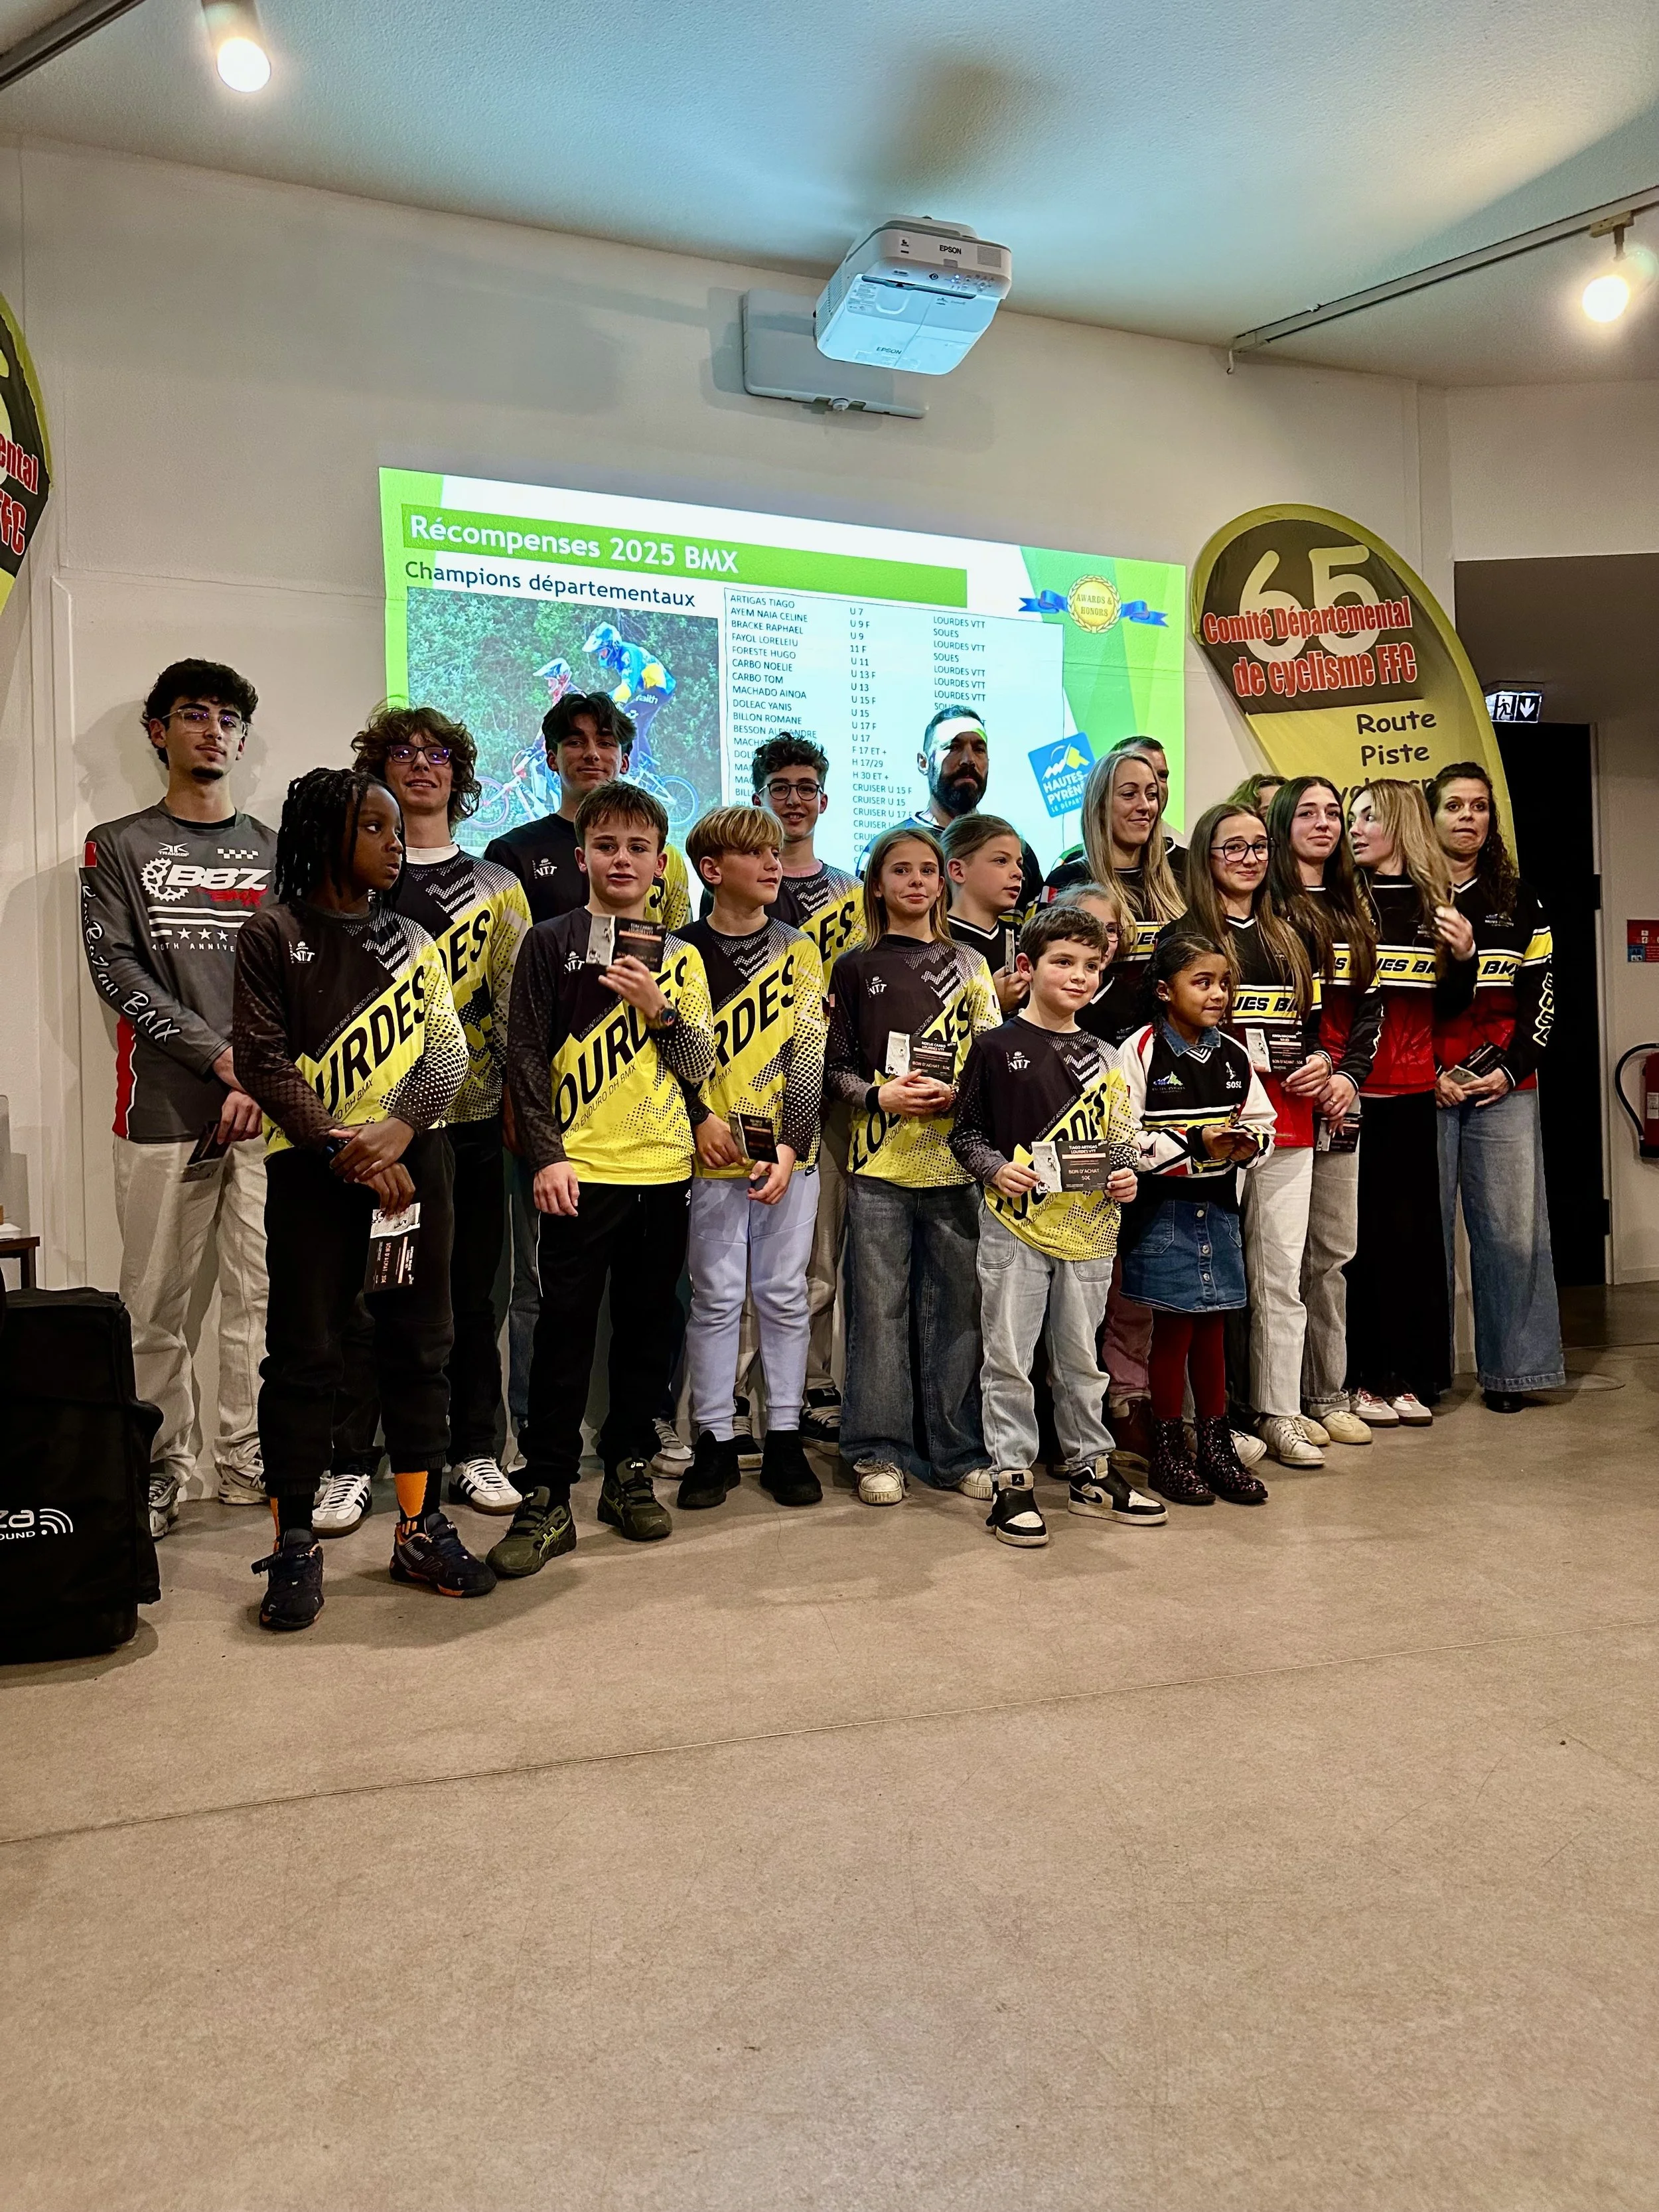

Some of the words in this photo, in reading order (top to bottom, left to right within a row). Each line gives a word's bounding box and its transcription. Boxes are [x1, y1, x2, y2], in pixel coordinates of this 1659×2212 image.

[939, 245, 962, 255] EPSON
[876, 346, 902, 355] EPSON
[409, 514, 601, 559] Récompenses
[610, 536, 676, 566] 2025
[685, 546, 739, 574] BMX
[405, 560, 521, 589] Champions
[529, 573, 696, 607] départementaux
[730, 595, 766, 605] ARTIGAS
[769, 599, 795, 609] TIAGO
[1076, 593, 1106, 604] AWARDS
[1239, 544, 1380, 664] 65
[731, 607, 755, 617] AYEM
[757, 610, 778, 619] NAIA
[780, 612, 808, 623] CELINE
[1080, 606, 1108, 617] HONORS
[933, 616, 969, 627] LOURDES
[971, 621, 985, 629] VTT
[1203, 609, 1273, 644] Comité
[1273, 595, 1413, 640] Départemental
[731, 620, 764, 630] BRACKE
[766, 623, 804, 634] RAPHAEL
[933, 628, 960, 638] SOUES
[732, 632, 757, 643] FAYOL
[850, 644, 859, 653] 11
[933, 640, 970, 651] LOURDES
[732, 646, 768, 656] FORESTE
[770, 650, 796, 659] HUGO
[933, 652, 960, 662] SOUES
[732, 658, 761, 669] CARBO
[764, 662, 793, 672] NOELIE
[1232, 656, 1266, 698] de
[1267, 650, 1376, 698] cyclisme
[1376, 642, 1417, 685] FFC
[851, 669, 857, 678] U
[859, 670, 869, 679] 13
[934, 665, 970, 676] LOURDES
[971, 669, 985, 678] VTT
[732, 672, 761, 682] CARBO
[764, 674, 784, 684] TOM
[934, 677, 970, 688] LOURDES
[971, 680, 985, 690] VTT
[732, 685, 778, 697] MACHADO
[779, 689, 807, 699] AINOA
[851, 682, 857, 691] U
[934, 690, 970, 701] LOURDES
[971, 694, 986, 702] VTT
[733, 699, 766, 709] DOLEAC
[768, 701, 792, 711] YANIS
[733, 712, 762, 722] BILLON
[765, 714, 802, 725] ROMANE
[1356, 710, 1437, 735] Route
[733, 725, 766, 735] BESSON
[1361, 743, 1430, 767] Piste
[861, 759, 883, 768] 17/29
[853, 783, 886, 793] CRUISER
[853, 796, 885, 805] CRUISER
[853, 808, 887, 817] CRUISER
[853, 820, 887, 829] CRUISER
[536, 865, 557, 877] VTT
[292, 950, 315, 962] VTT
[564, 960, 585, 972] VTT
[869, 983, 887, 995] VTT
[121, 991, 181, 1043] BMX
[1009, 1059, 1031, 1070] VTT
[609, 1078, 619, 1096] DH
[620, 1062, 637, 1084] BMX
[1226, 1080, 1242, 1089] SOSL
